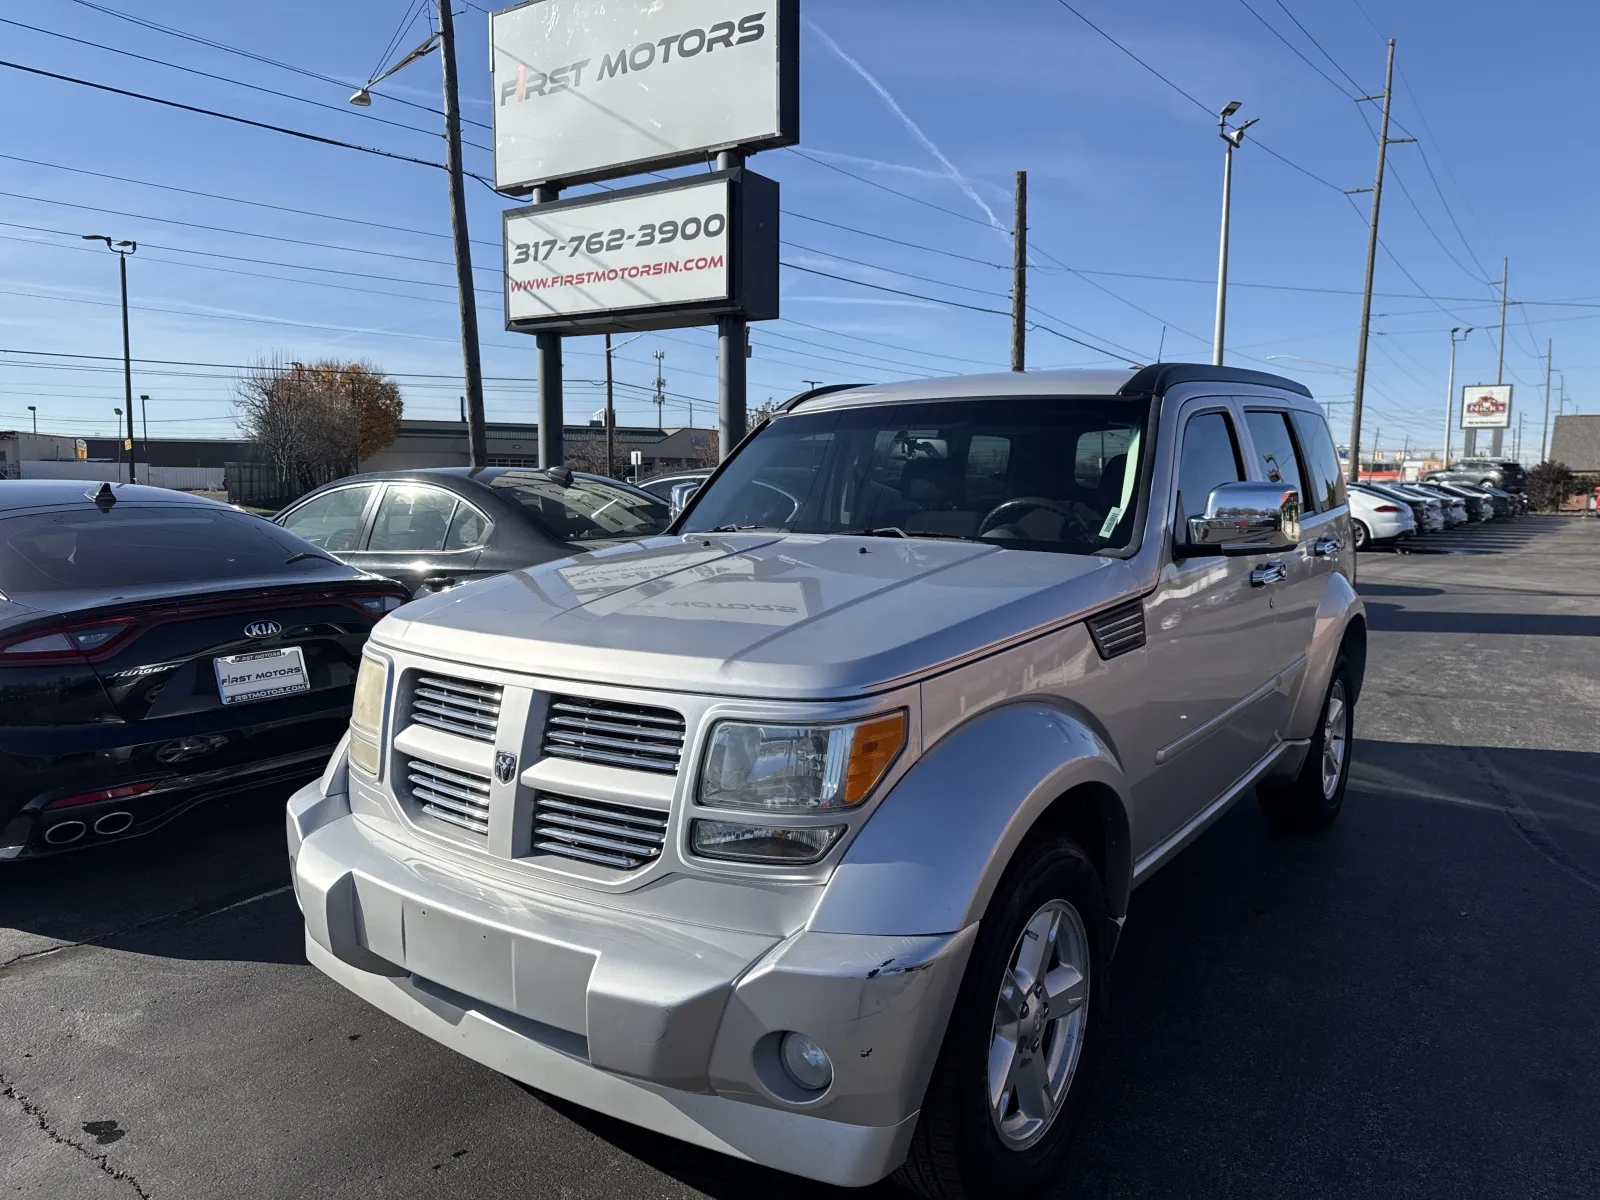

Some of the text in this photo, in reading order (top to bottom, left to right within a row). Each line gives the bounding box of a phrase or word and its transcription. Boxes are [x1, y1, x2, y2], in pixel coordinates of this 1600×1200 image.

[597, 12, 766, 81] MOTORS
[513, 213, 725, 264] 317-762-3900
[511, 255, 724, 292] WWW.FIRSTMOTORSIN.COM
[250, 622, 277, 636] KIA
[255, 667, 301, 679] MOTORS
